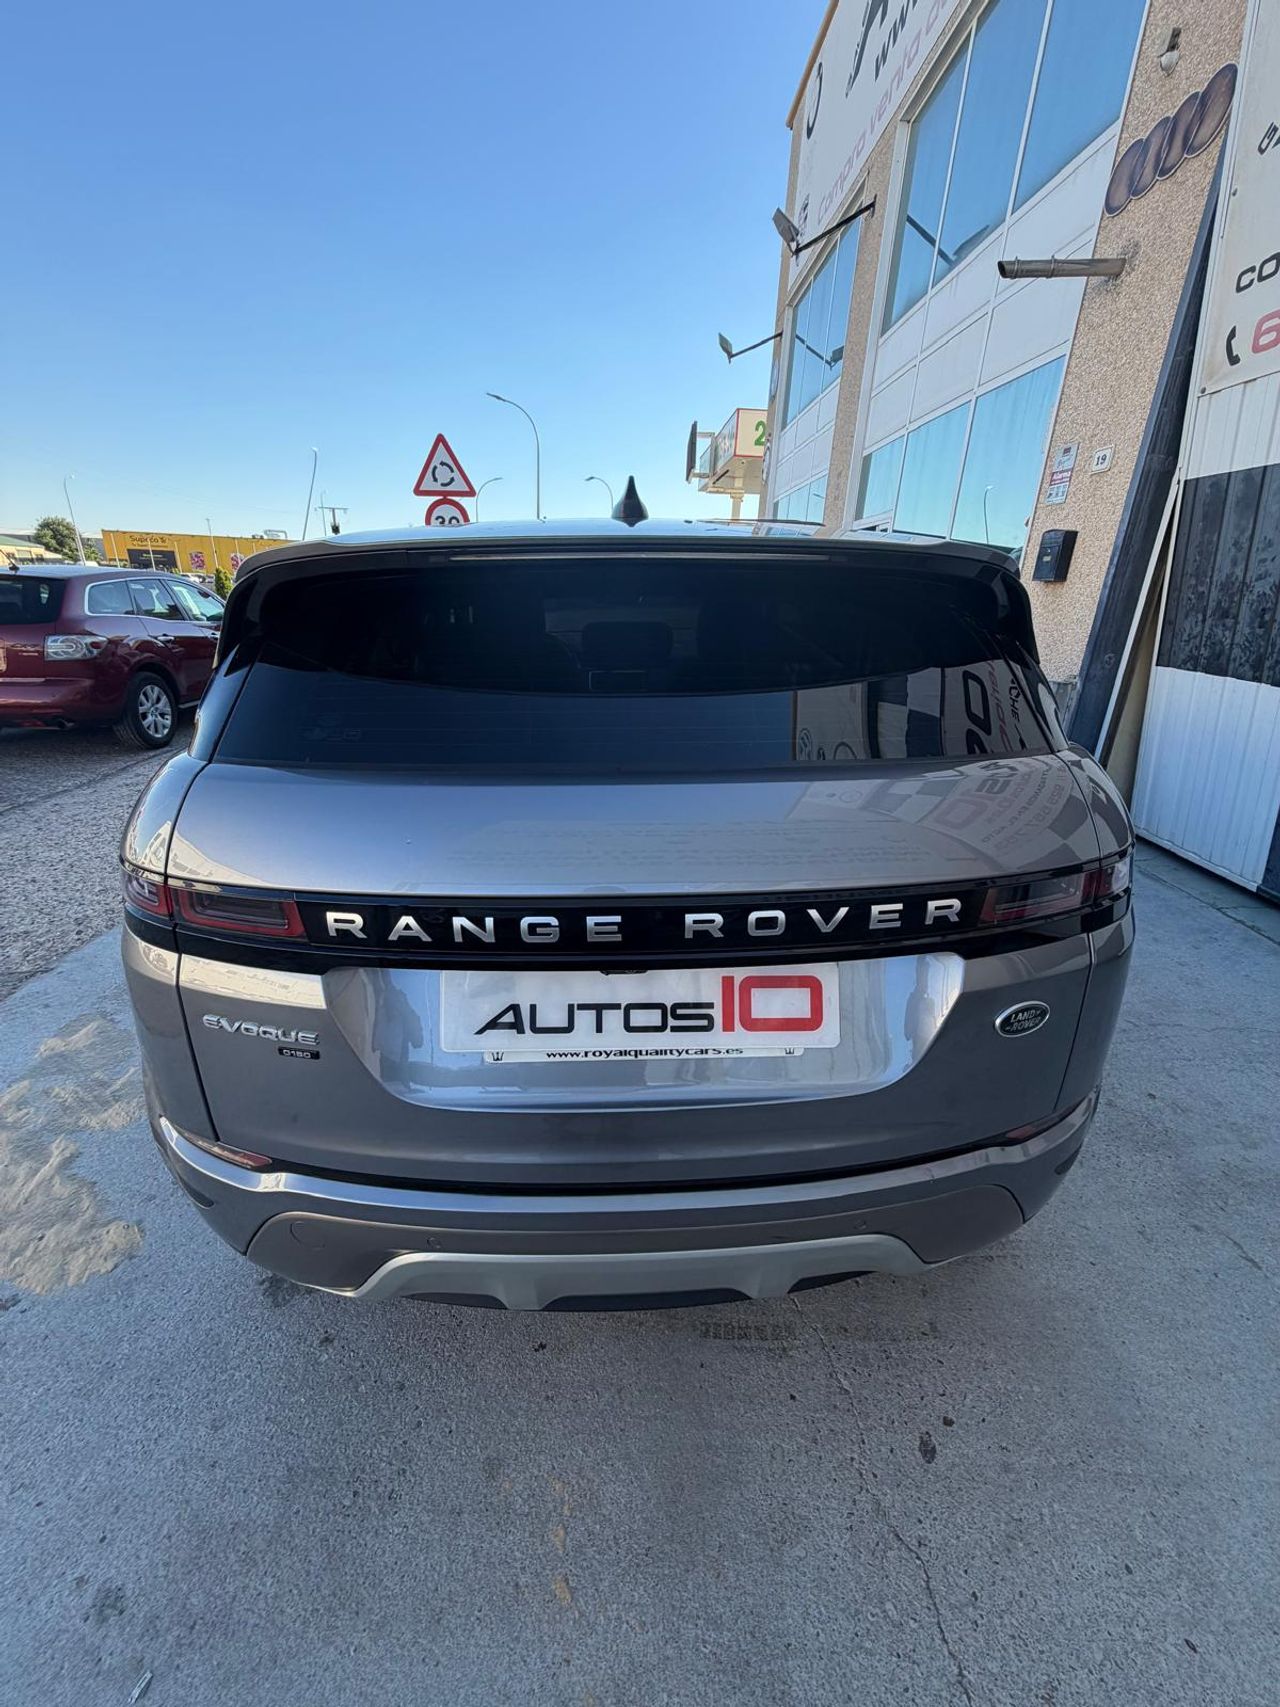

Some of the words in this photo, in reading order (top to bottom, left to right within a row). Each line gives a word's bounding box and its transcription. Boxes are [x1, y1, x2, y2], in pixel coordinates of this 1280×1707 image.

[1095, 453, 1108, 467] 19
[326, 911, 622, 943] RANGE
[684, 898, 962, 939] ROVER
[1010, 1010, 1036, 1023] LAND
[1011, 1016, 1041, 1032] ROVER
[202, 1013, 320, 1046] EVOQUE
